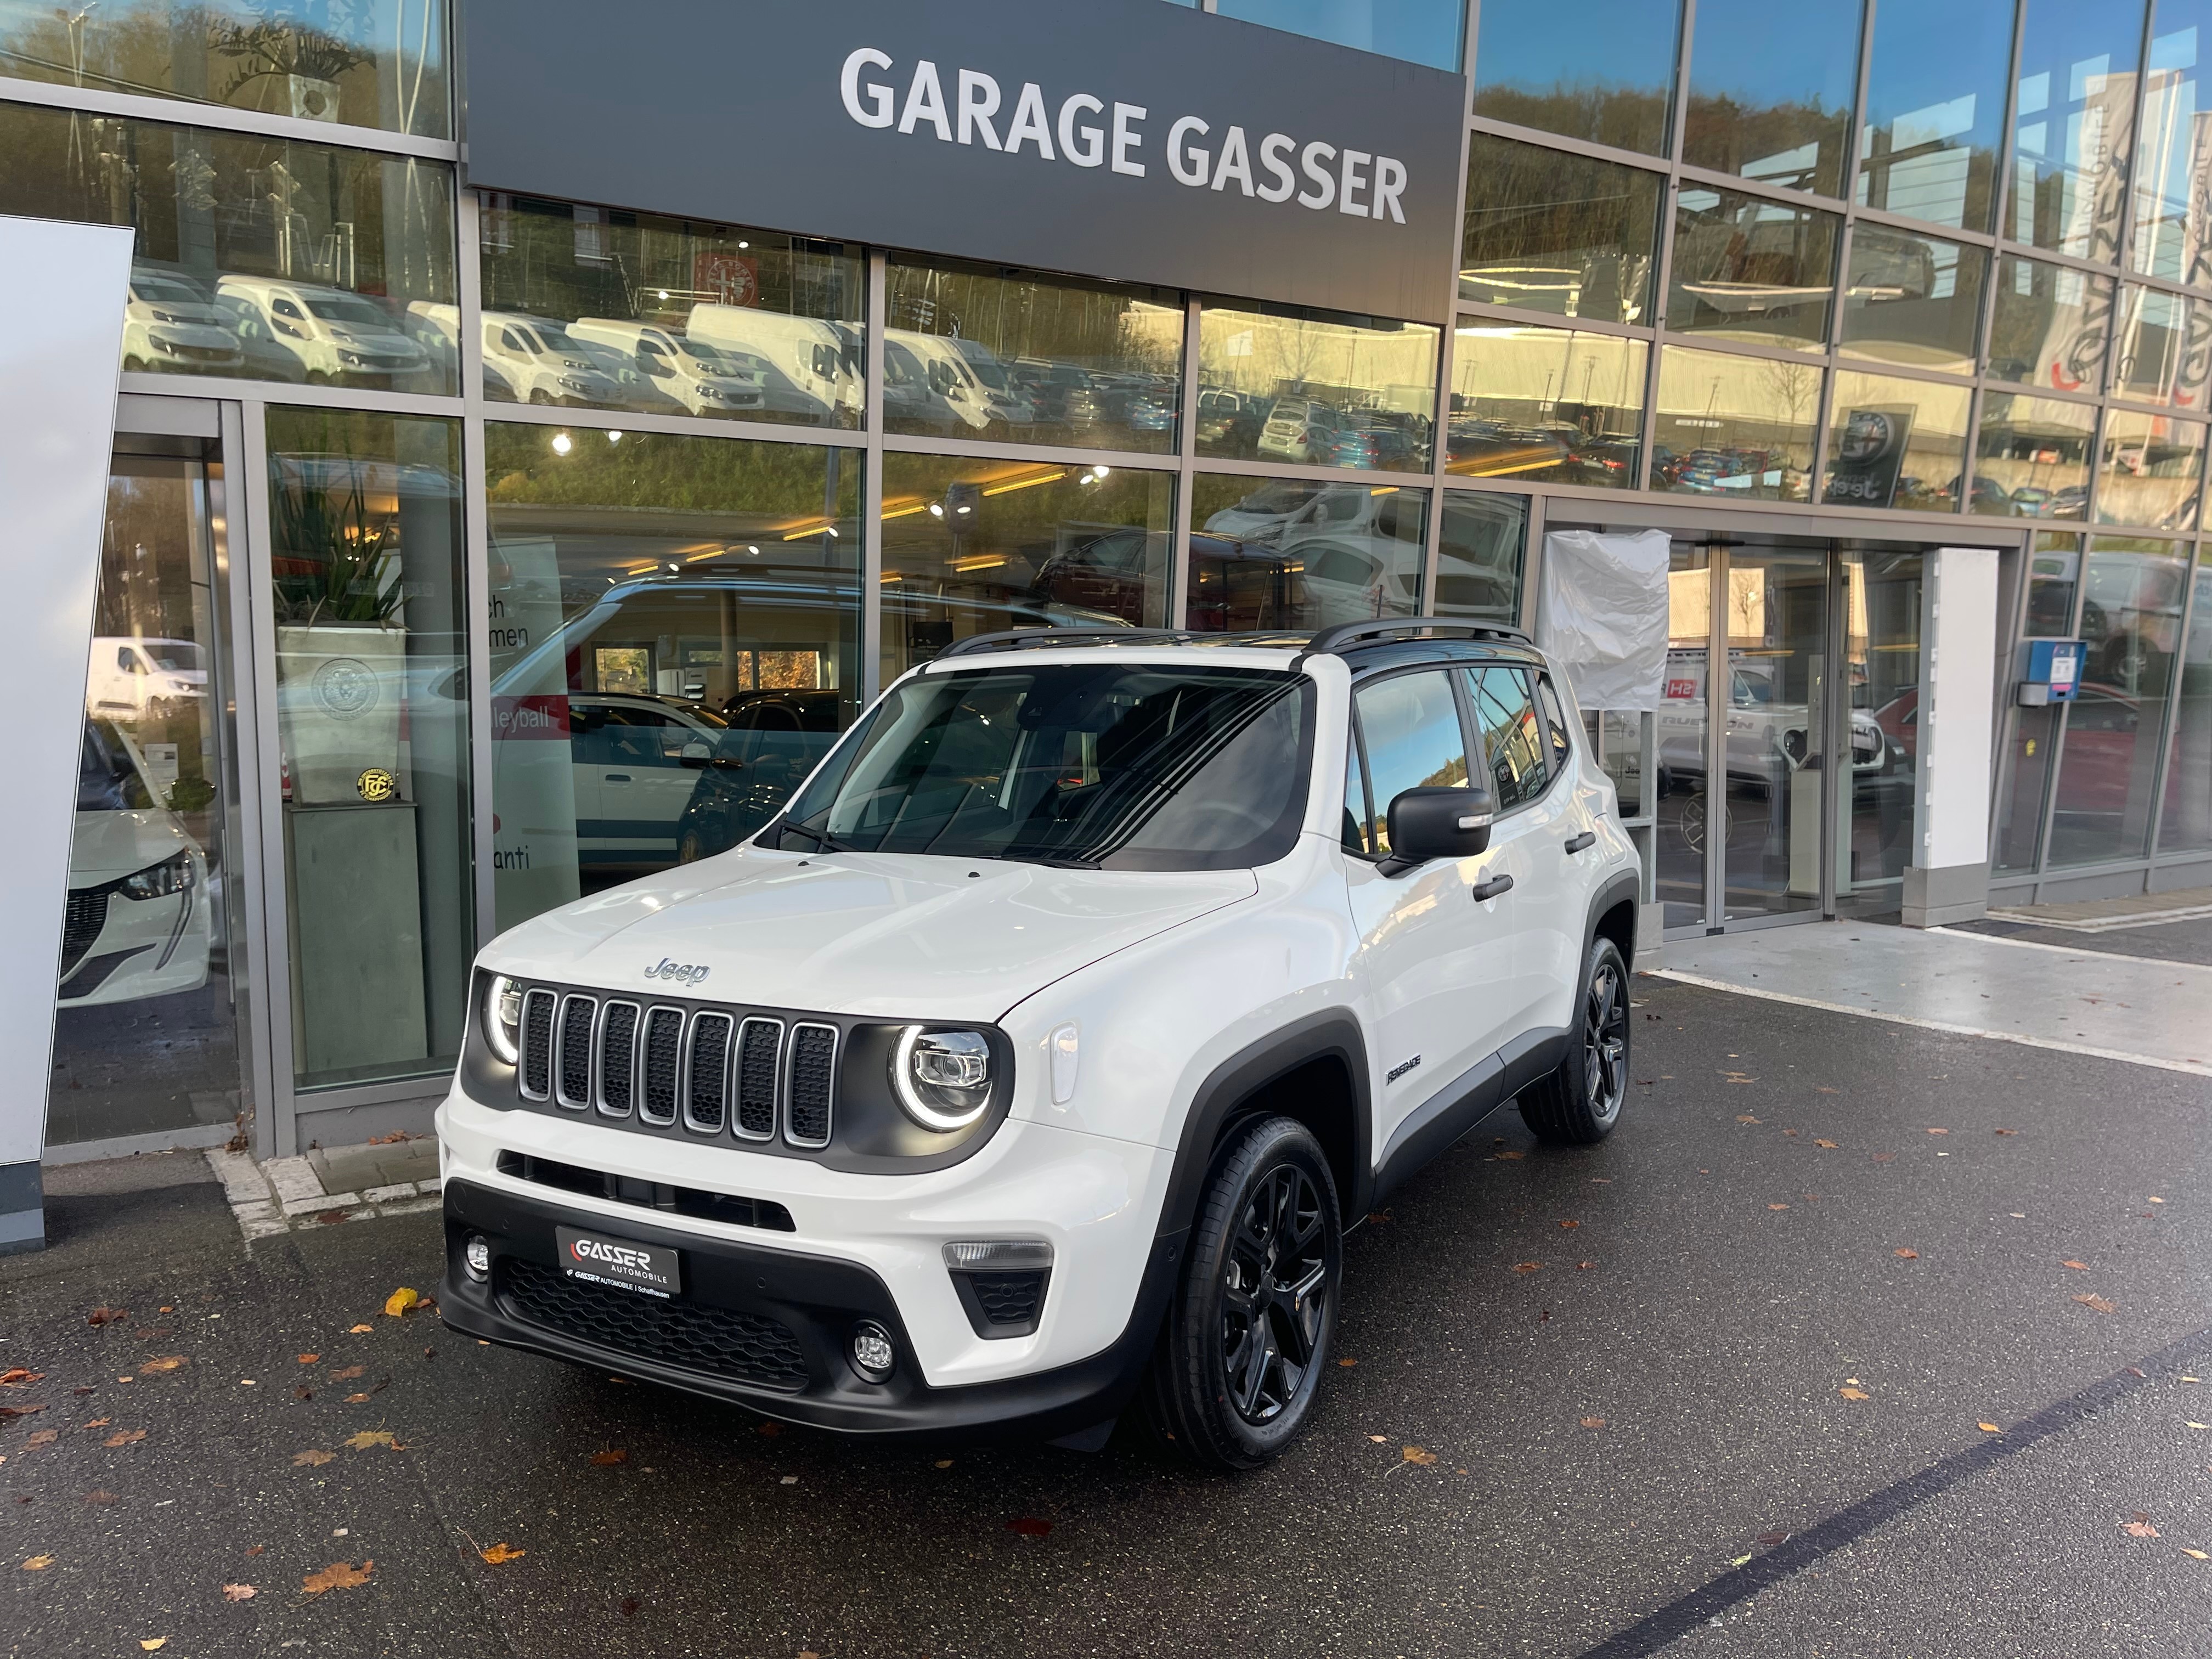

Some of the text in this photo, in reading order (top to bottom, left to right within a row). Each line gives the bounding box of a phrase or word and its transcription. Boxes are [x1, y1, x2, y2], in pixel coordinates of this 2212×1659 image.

[840, 47, 1408, 224] GARAGE GASSER
[644, 957, 710, 987] Jeep
[575, 1239, 651, 1271] GASSER
[575, 1271, 600, 1282] GASSER
[600, 1278, 633, 1290] AUTOMOBILE
[638, 1286, 670, 1299] Schaffhausen
[611, 1265, 667, 1284] AUTOMOBILE
